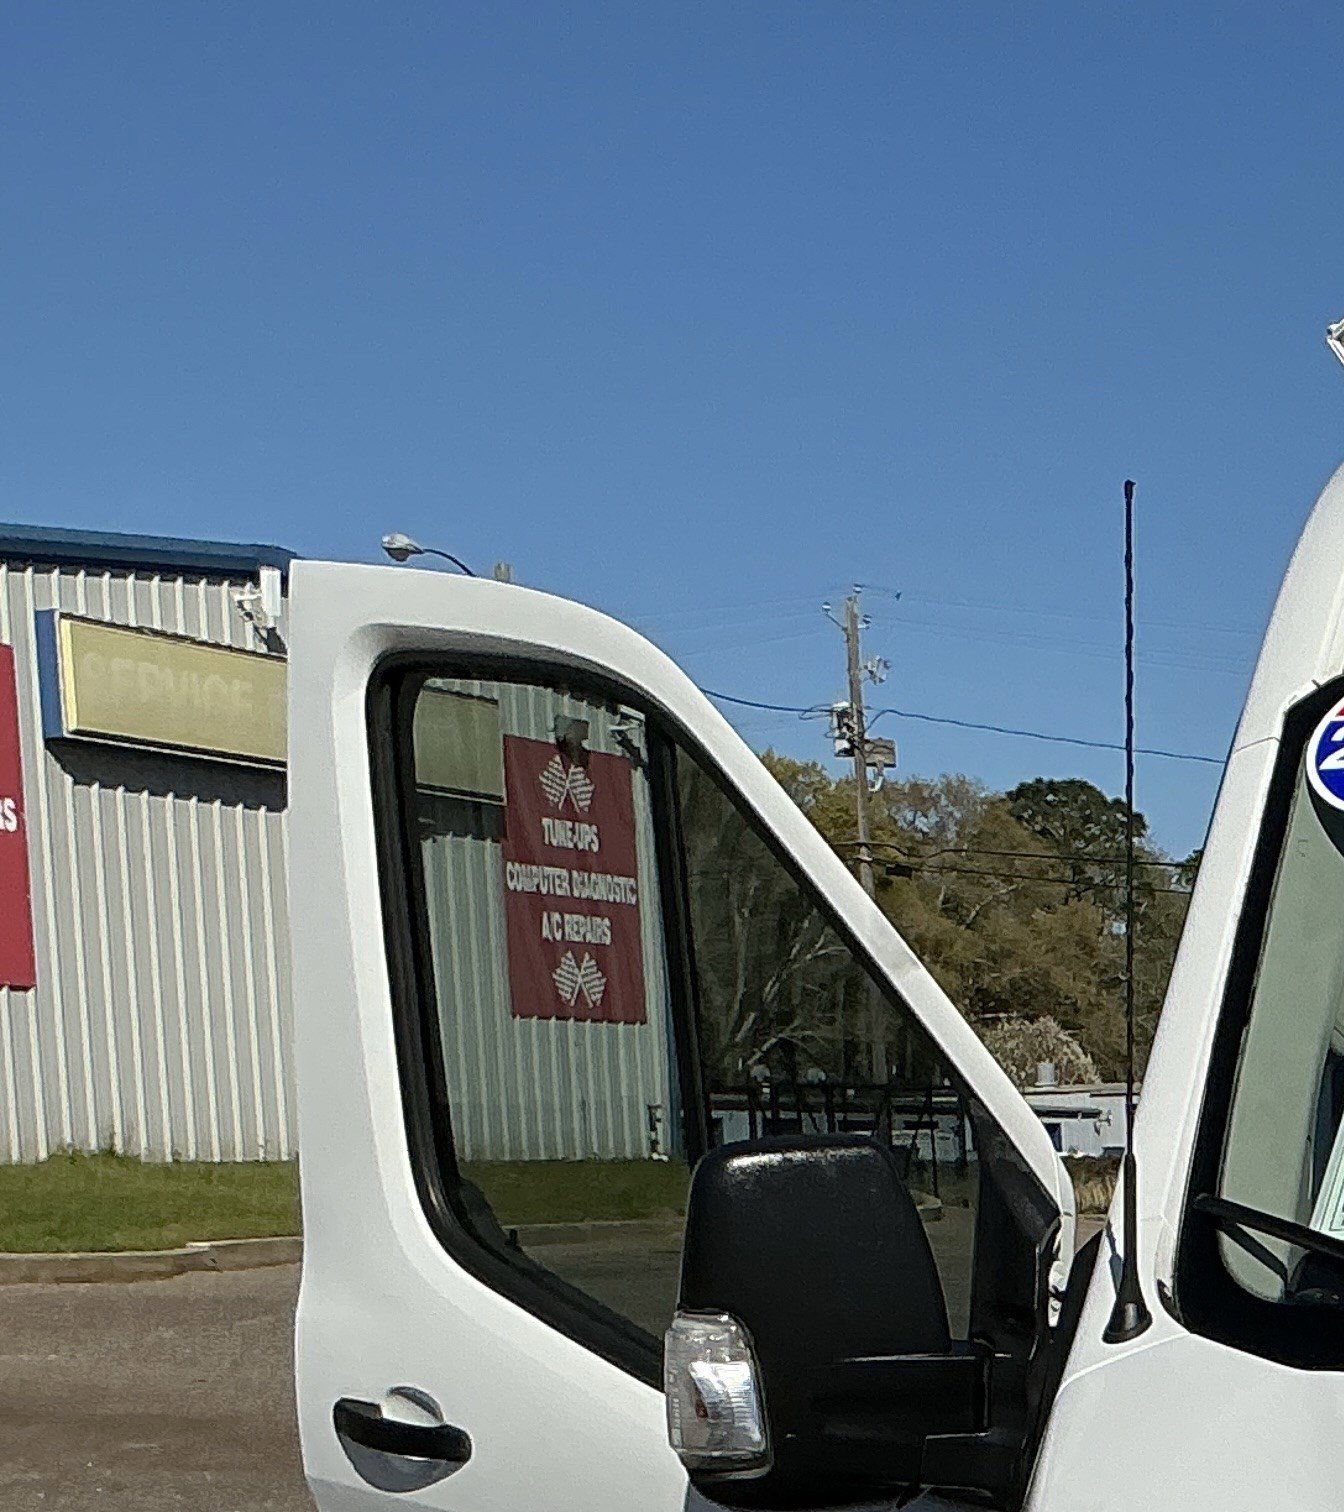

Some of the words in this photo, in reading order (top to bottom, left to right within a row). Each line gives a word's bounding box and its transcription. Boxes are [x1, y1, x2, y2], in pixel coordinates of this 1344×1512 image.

[541, 817, 599, 853] TUNE-UPS
[506, 861, 571, 896] COMPUTER
[571, 869, 637, 905] DIAGNOSTIC
[563, 913, 612, 945] REPAIRS
